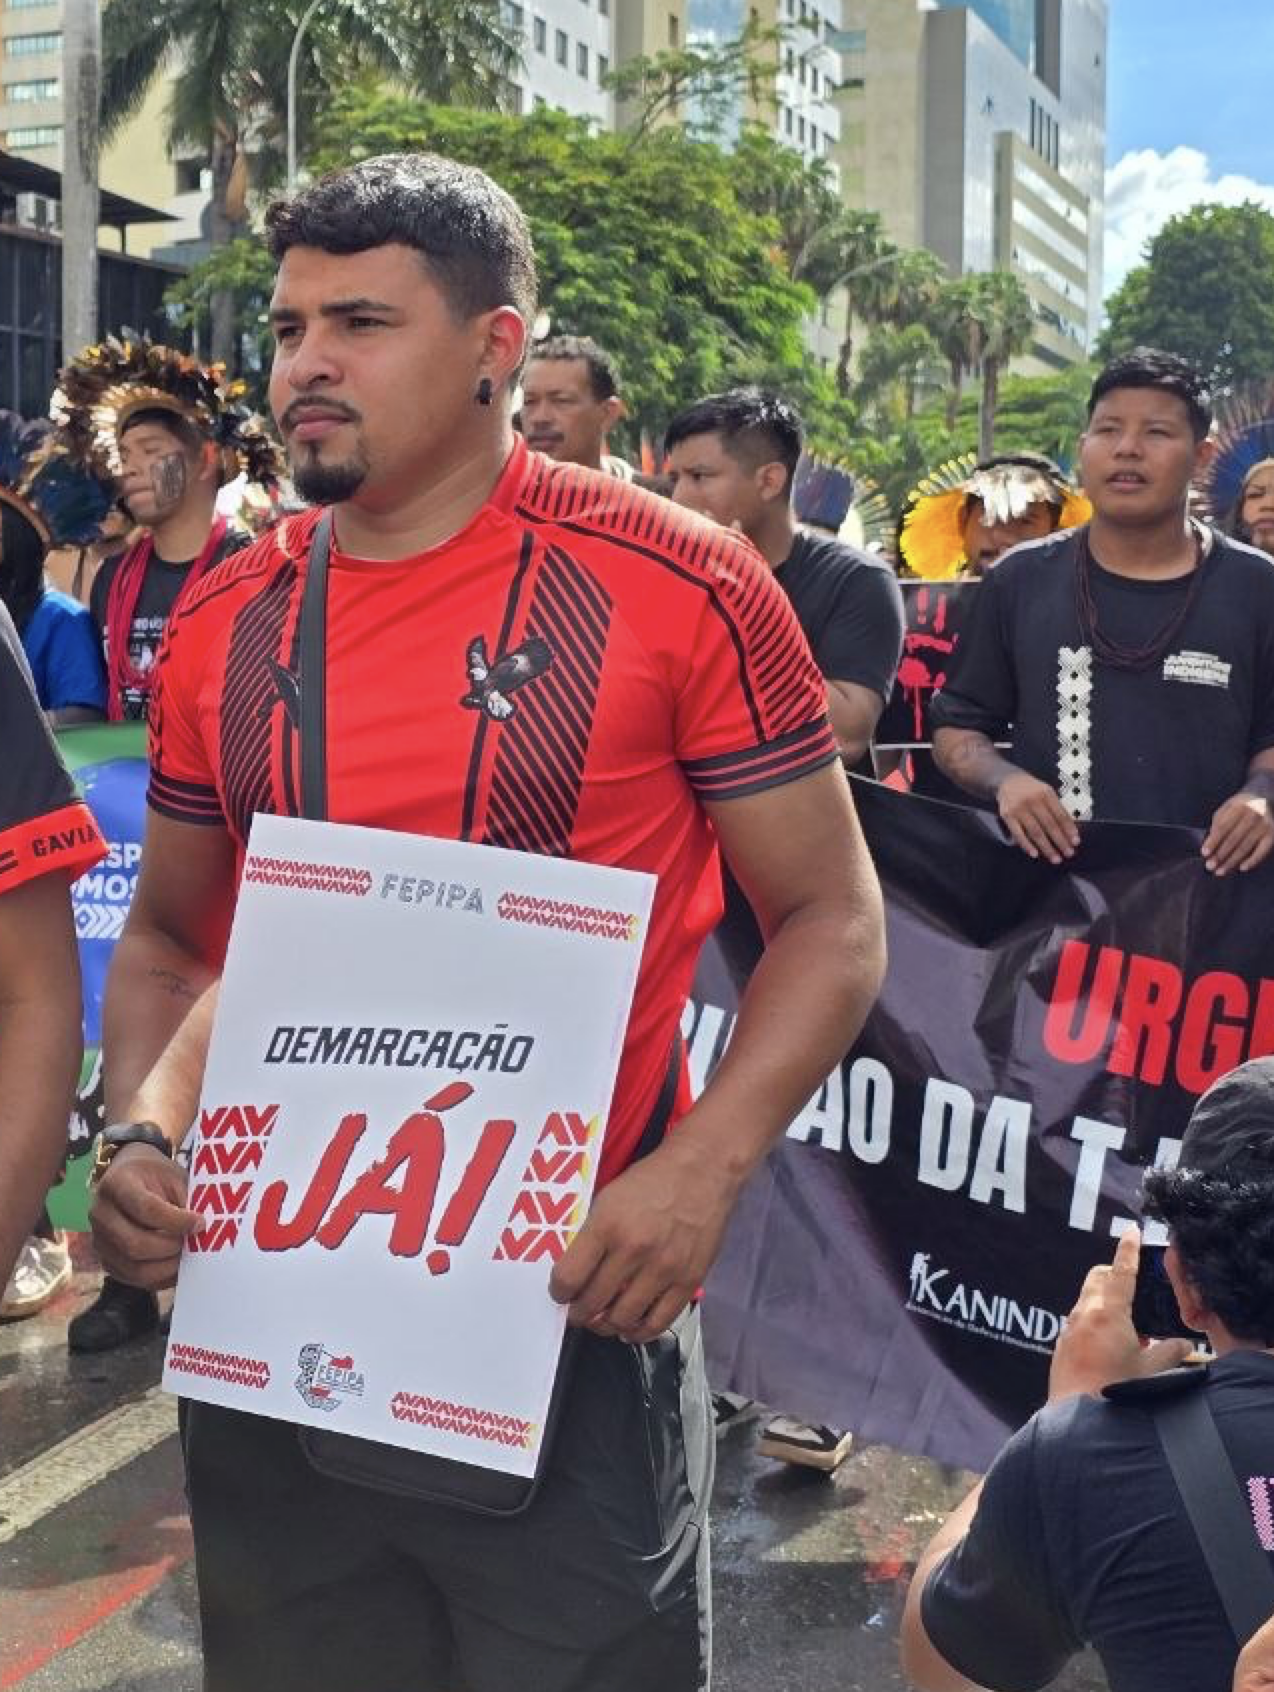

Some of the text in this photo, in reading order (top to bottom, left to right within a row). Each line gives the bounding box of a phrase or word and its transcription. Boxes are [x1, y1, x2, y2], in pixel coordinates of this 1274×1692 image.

[379, 873, 485, 915] FEPIPA
[264, 1022, 535, 1075] DEMARCAÇÃO
[253, 1080, 517, 1277] JÁ!
[917, 1077, 1033, 1214] DA
